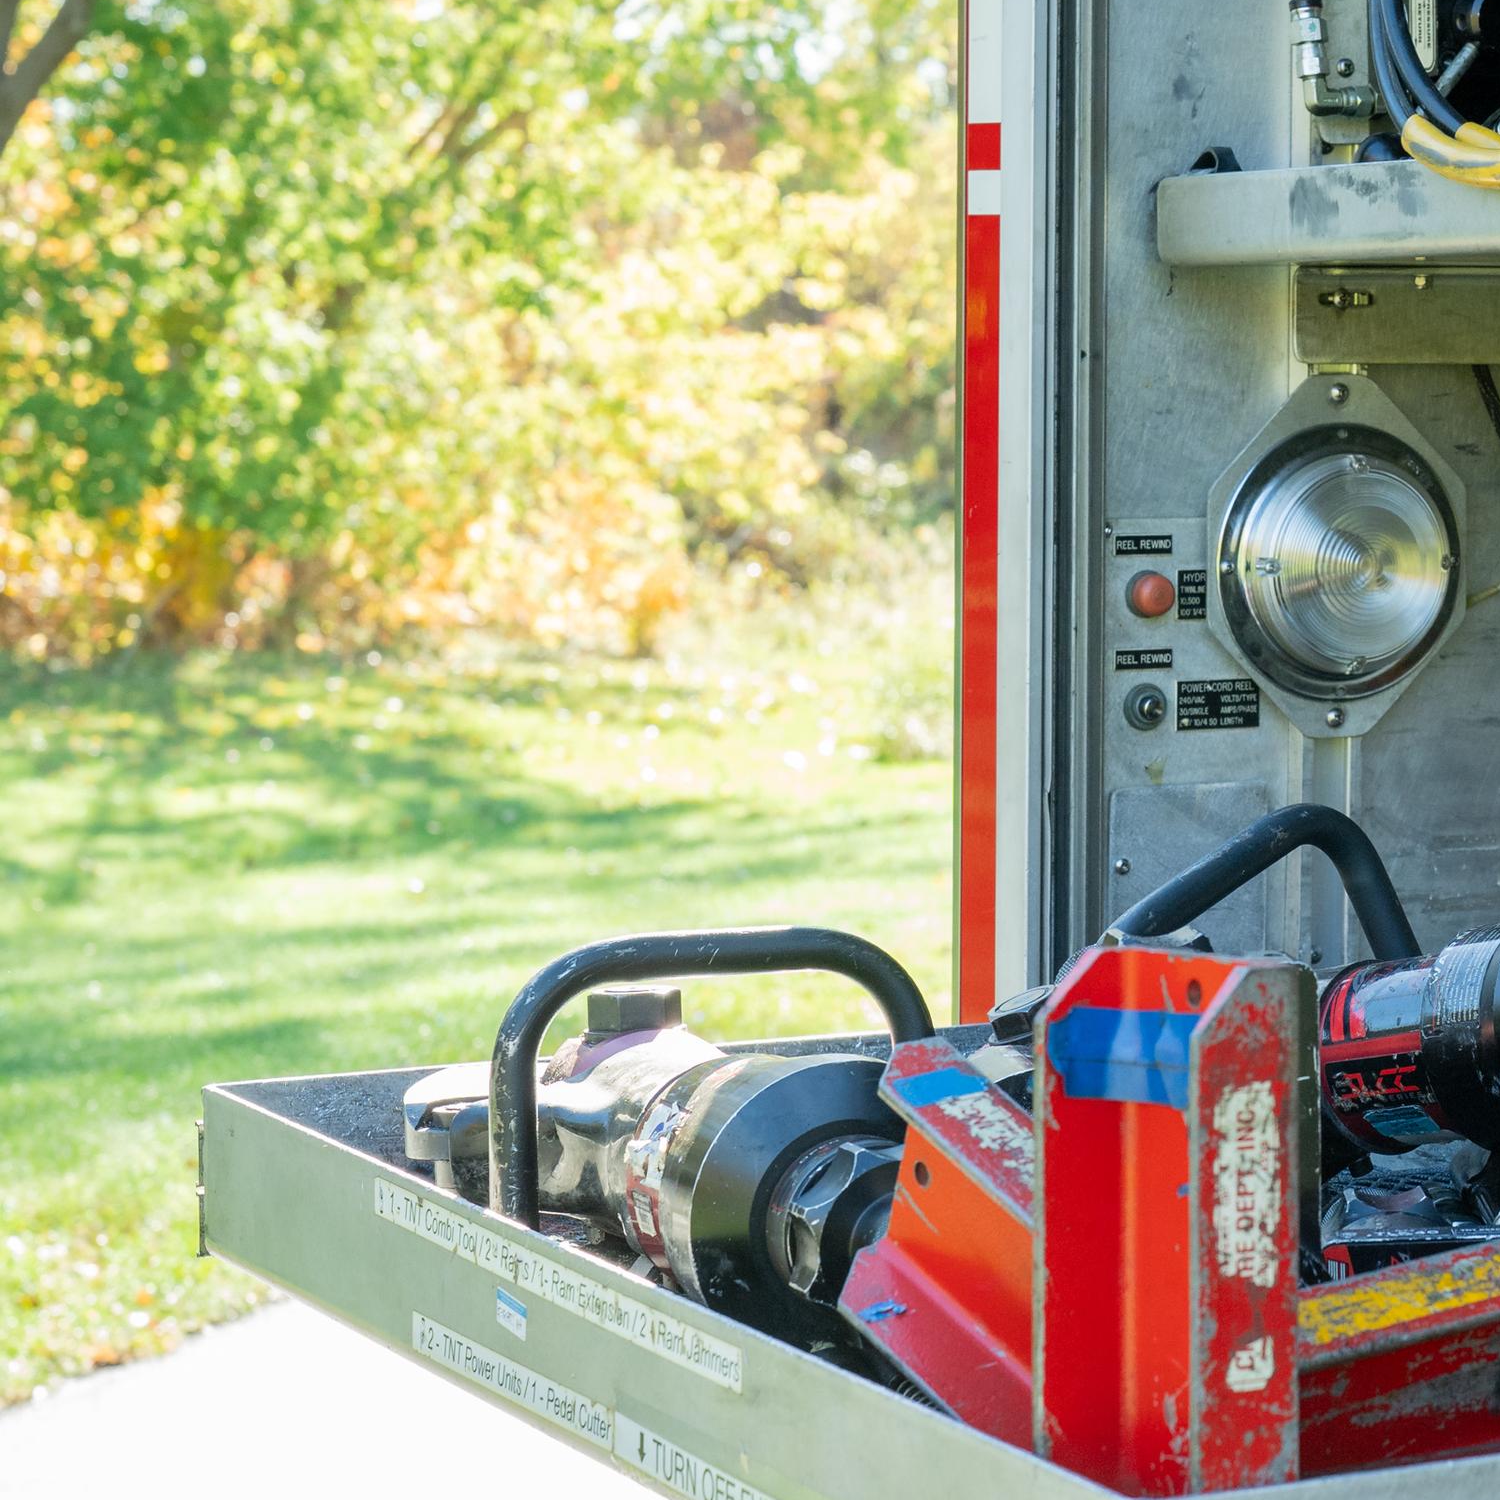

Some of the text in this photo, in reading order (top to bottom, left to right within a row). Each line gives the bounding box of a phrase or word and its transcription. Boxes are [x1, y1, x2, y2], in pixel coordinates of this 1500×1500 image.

[1116, 539, 1172, 550] REEL REWIND
[1116, 653, 1172, 665] REEL REWIND
[1181, 681, 1255, 693] POWER CORD REEL
[1220, 716, 1243, 725] LENGTH
[404, 1198, 424, 1227] TNT
[425, 1208, 455, 1243] Combi
[457, 1223, 478, 1255] Tool
[485, 1237, 492, 1262] 2
[551, 1270, 575, 1300] Ram
[578, 1283, 629, 1328] Extension
[639, 1313, 646, 1338] 2
[658, 1320, 685, 1355] Ram
[687, 1334, 740, 1384] Jammers
[428, 1327, 433, 1350] 2
[443, 1333, 463, 1366] TNT
[465, 1346, 495, 1382] Power
[498, 1362, 522, 1396] Units
[546, 1387, 577, 1424] Pedal
[579, 1403, 612, 1441] Cutter
[652, 1438, 697, 1496] TURN
